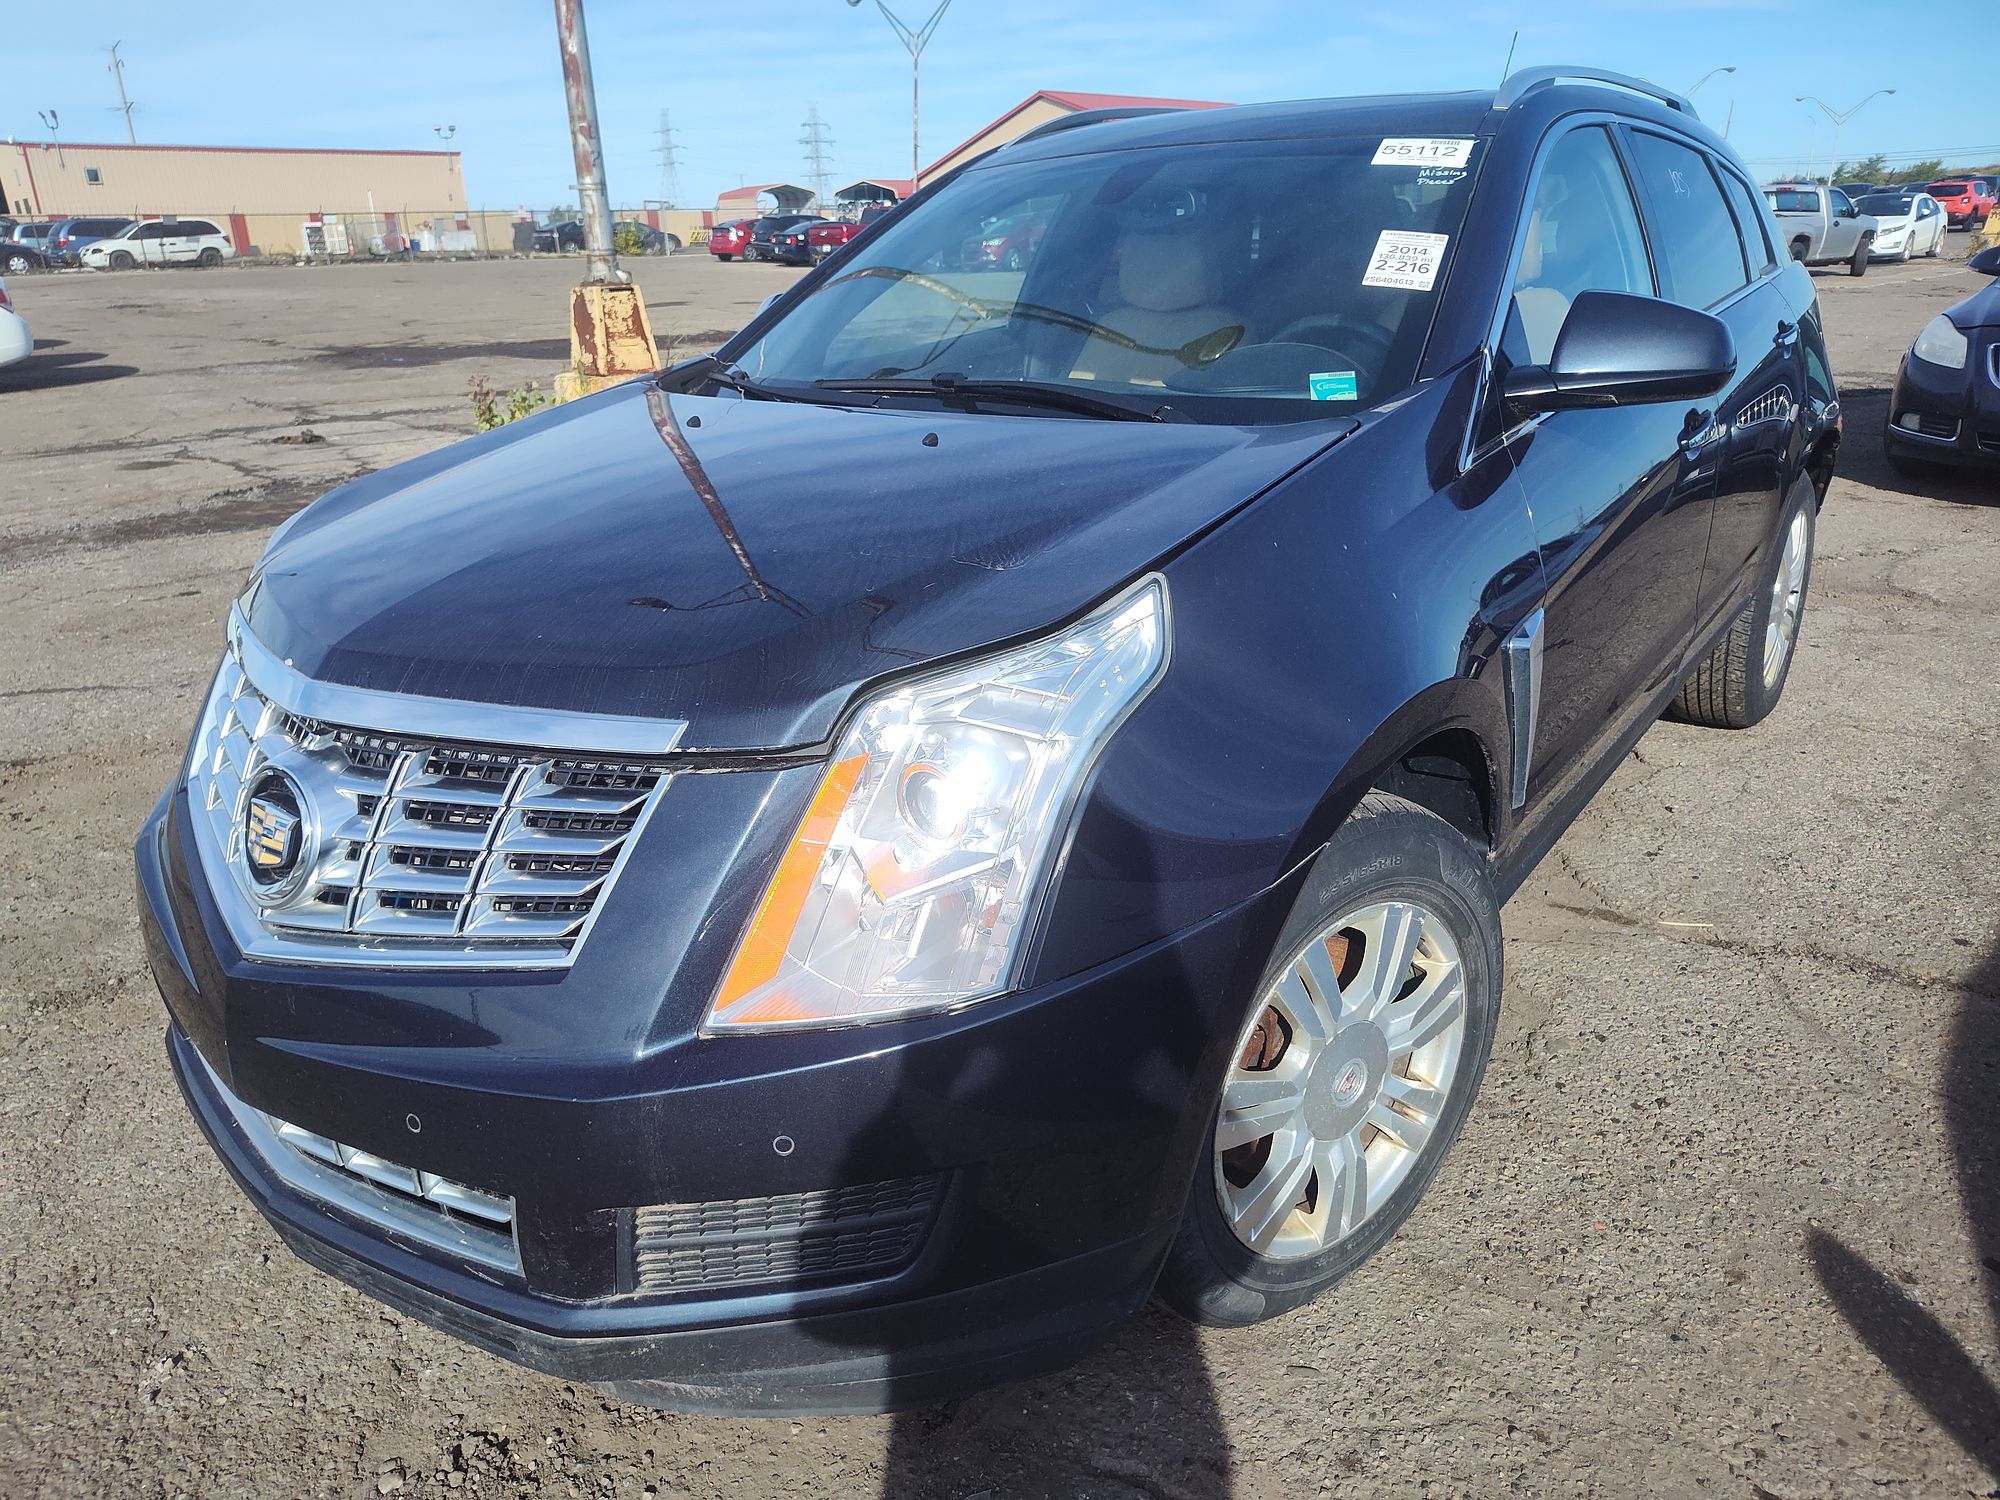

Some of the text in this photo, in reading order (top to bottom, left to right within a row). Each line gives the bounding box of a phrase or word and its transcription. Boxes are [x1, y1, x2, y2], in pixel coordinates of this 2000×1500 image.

[1381, 146, 1458, 157] 55112
[1388, 245, 1428, 256] 2014
[1374, 259, 1431, 274] 2-216
